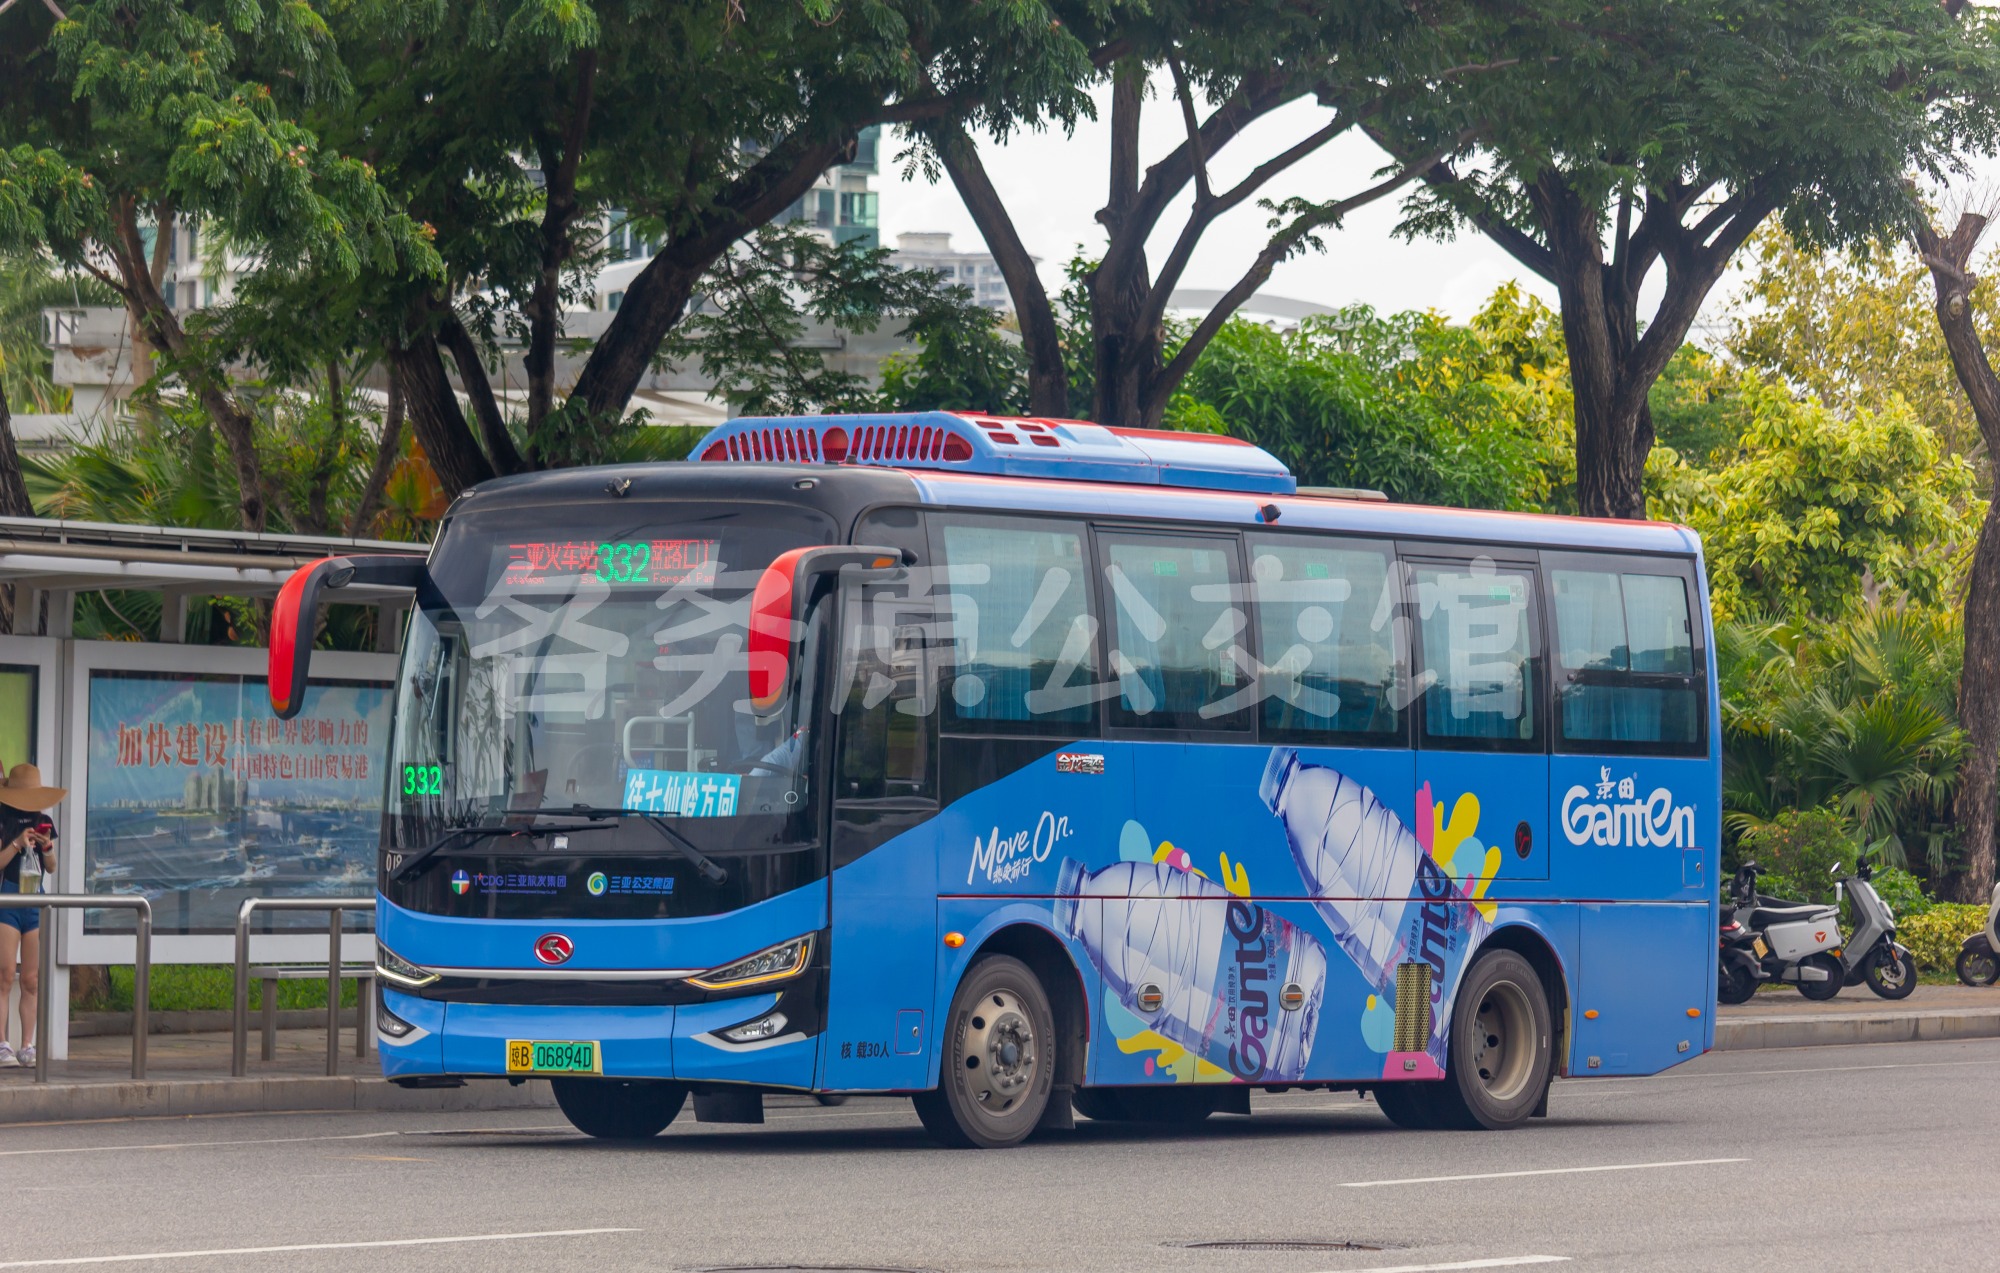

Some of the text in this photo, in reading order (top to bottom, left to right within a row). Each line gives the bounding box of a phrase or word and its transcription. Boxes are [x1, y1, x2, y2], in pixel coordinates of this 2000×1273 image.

[596, 543, 650, 583] 332
[115, 721, 229, 769] 加快建设
[231, 718, 369, 747] 具有世界影响力的
[231, 752, 369, 782] 中国特色自由贸易港
[404, 766, 441, 795] 332
[1595, 764, 1635, 800] 景田
[627, 772, 736, 817] 往七仙岭方向
[967, 810, 1074, 886] Move On.
[610, 876, 675, 890] 三亚公交集团
[537, 1046, 592, 1067] 06894D
